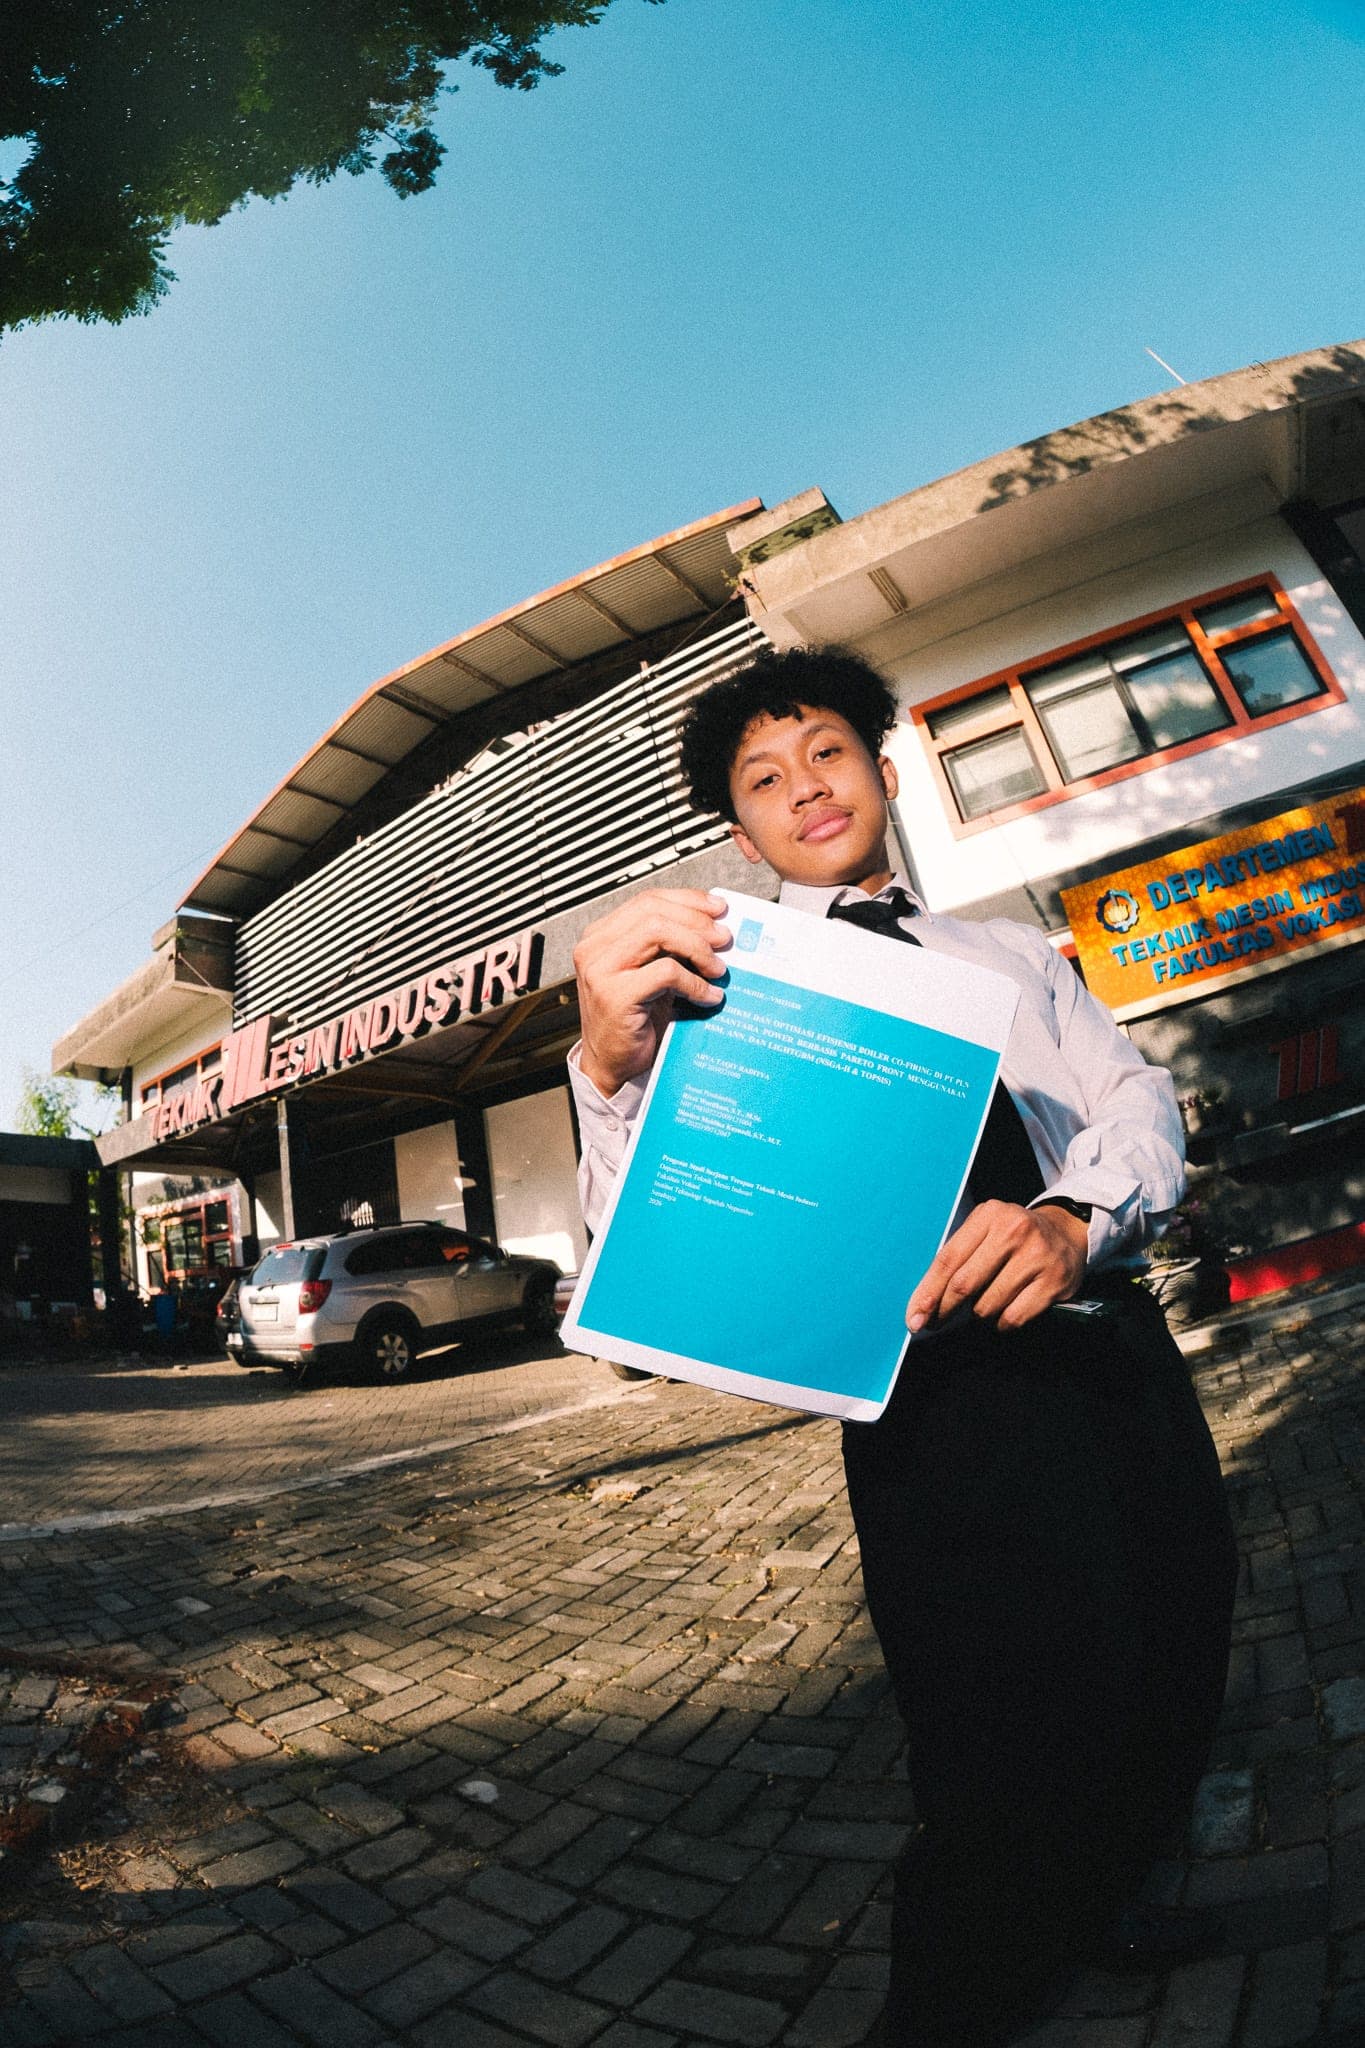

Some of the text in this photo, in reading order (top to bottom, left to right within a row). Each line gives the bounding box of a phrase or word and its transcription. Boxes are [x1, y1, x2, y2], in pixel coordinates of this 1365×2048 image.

[1146, 822, 1337, 911] DEPARTEMEN
[1111, 917, 1211, 966] TEKNIK
[1216, 889, 1295, 933] MESIN
[1153, 895, 1364, 983] FAKULTAS VOKASI
[148, 1078, 220, 1141] TEKNIK
[339, 930, 538, 1062] INDUSTRI
[748, 1035, 766, 1047] DAN
[768, 1041, 815, 1061] LIGHTGBM
[852, 1067, 859, 1076] &
[861, 1070, 892, 1087] TOPSIS)
[752, 1012, 772, 1024] DAN
[773, 1017, 815, 1039] OPTIMASI
[816, 1032, 857, 1052] EFISIENSI
[859, 1045, 890, 1062] BOILER
[891, 1056, 933, 1076] CO-FIRING
[934, 1070, 943, 1081] DI
[944, 1074, 954, 1084] PT
[763, 1029, 794, 1044] POWER
[797, 1038, 838, 1058] BERBASIS
[841, 1051, 875, 1069] PARETO
[877, 1063, 905, 1080] FRONT
[907, 1073, 967, 1099] MENGGUNAKAN
[755, 1183, 776, 1195] Teknik
[777, 1190, 795, 1201] Mesin
